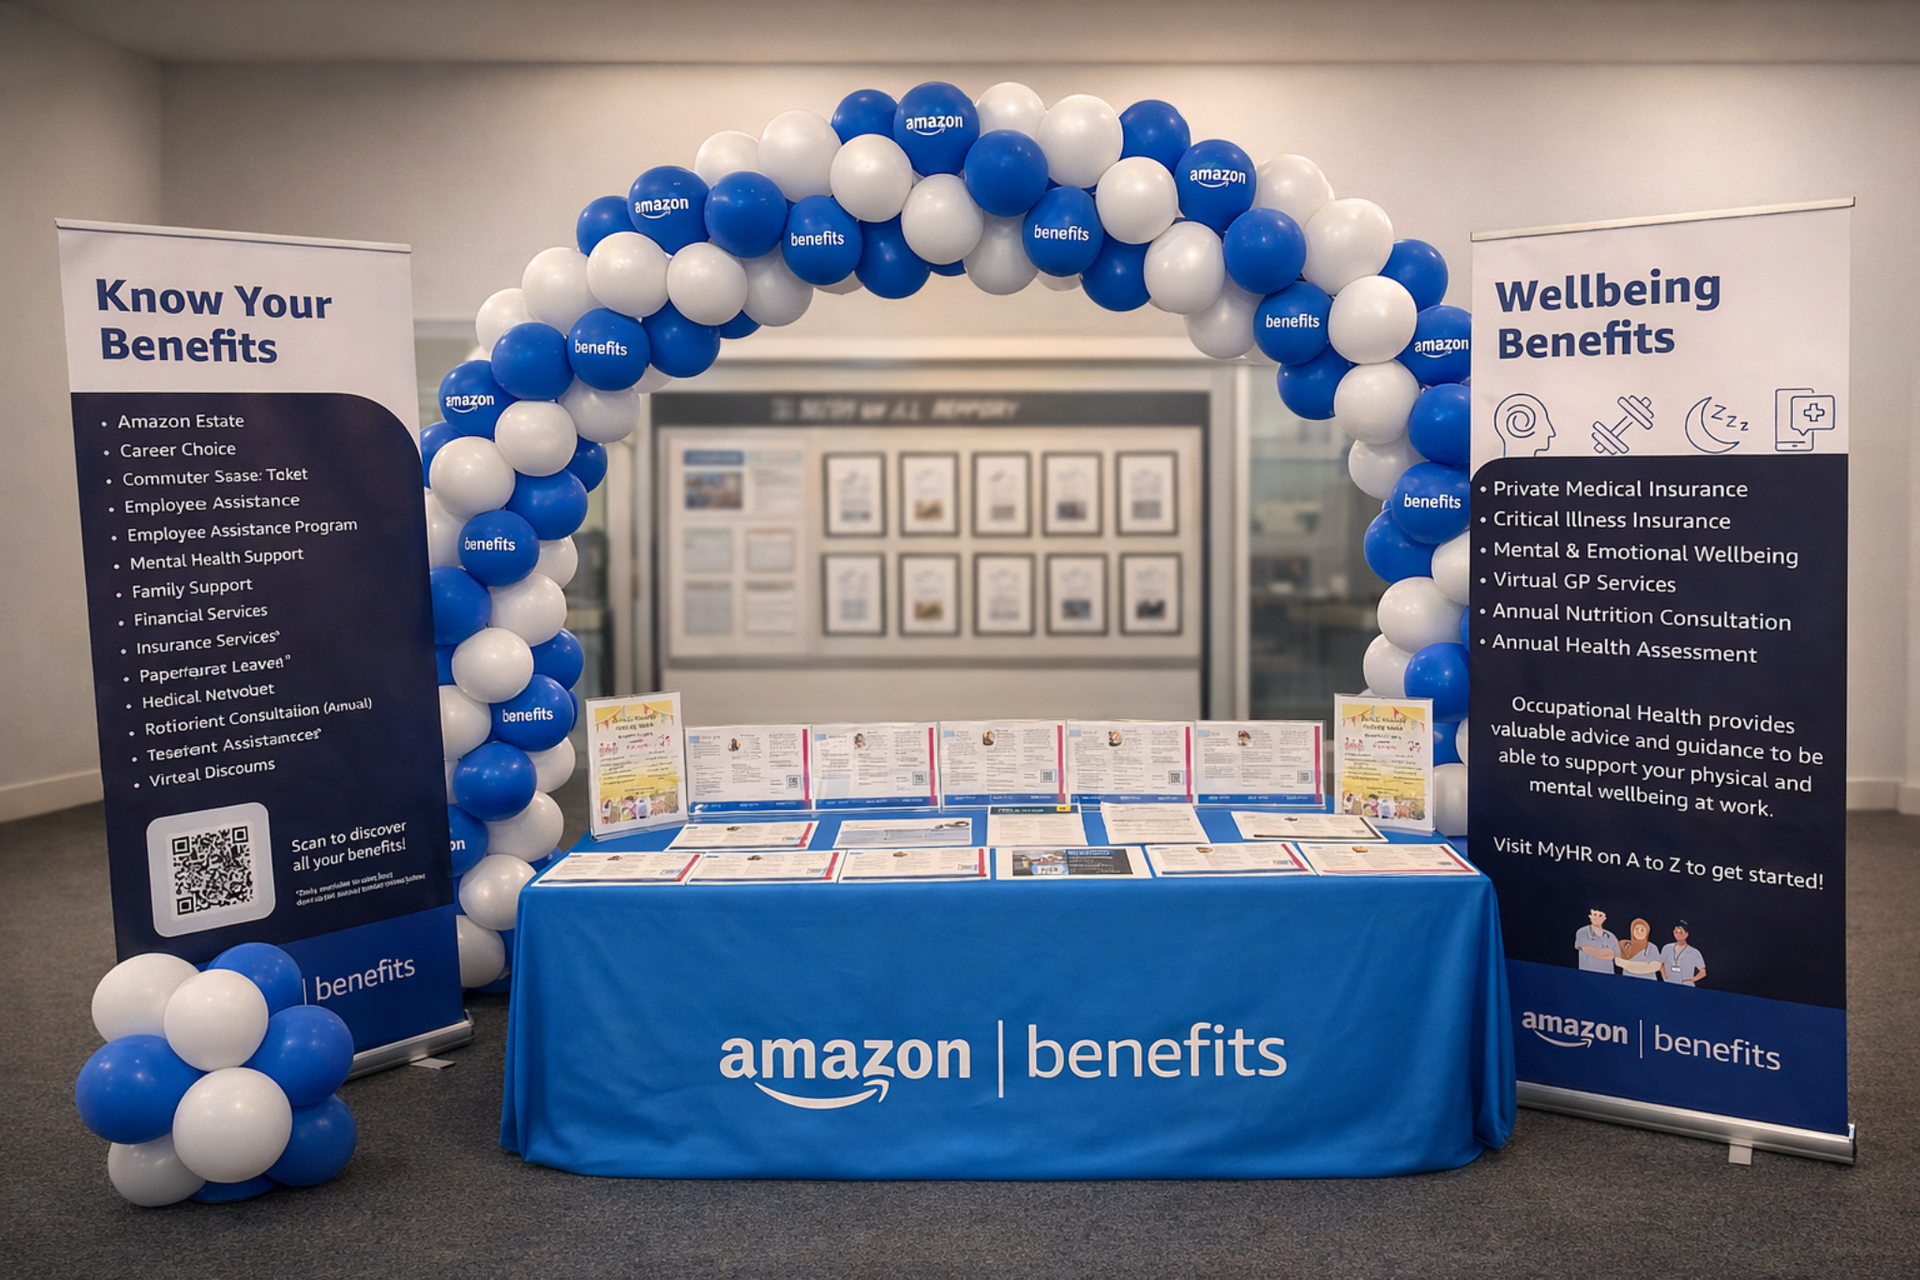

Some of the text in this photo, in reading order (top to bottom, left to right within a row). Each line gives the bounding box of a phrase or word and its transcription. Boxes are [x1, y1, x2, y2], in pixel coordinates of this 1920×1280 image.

[905, 114, 964, 131] amazon
[1189, 168, 1246, 184] amazon
[634, 197, 689, 214] amazon
[790, 231, 845, 247] benefits
[1034, 224, 1090, 241] benefits
[95, 278, 333, 320] Know Your
[1494, 268, 1721, 313] Wellbeing
[1265, 313, 1320, 329] benefits
[100, 327, 278, 364] Benefits
[574, 340, 628, 356] benefits
[1414, 338, 1470, 353] amazon
[1499, 319, 1676, 360] Benefits
[445, 394, 494, 408] amazon
[118, 414, 245, 429] Amazon Estate
[120, 441, 236, 458] Career Choice
[123, 472, 210, 486] Commuter
[1493, 480, 1748, 498] Private Medical Insurance
[125, 494, 300, 516] Employee Assistance
[1403, 493, 1462, 509] benefits
[128, 519, 358, 544] Employee Assistance Program
[1493, 511, 1731, 530] Critical Illness Insurance
[464, 537, 516, 552] benefits
[1493, 541, 1799, 569] Mental & Emotional Wellbeing
[130, 548, 304, 570] Mental Health Support
[132, 578, 253, 600] Family Support
[1493, 571, 1676, 593] Virtual GP Services
[134, 605, 268, 626] Financial Services
[1492, 603, 1792, 631] Annual Nutrition Consultation
[136, 637, 212, 655] Insurance
[1492, 634, 1757, 663] Annual Health Assessment
[503, 707, 554, 722] benefits
[1511, 696, 1795, 735] Occupational Health provides
[1491, 721, 1824, 765] valuable advice and guidance to be
[1498, 748, 1812, 793] able to support your physical and
[1529, 777, 1774, 817] mental wellbeing at work.
[291, 821, 407, 853] Scan to discover
[292, 837, 406, 872] all your benefits!
[1493, 836, 1824, 890] Visit MyHR on A to Z to get started!
[316, 957, 416, 1001] benefits
[719, 1022, 1288, 1080] amazon benefits
[1521, 1011, 1781, 1071] amazon benefits
